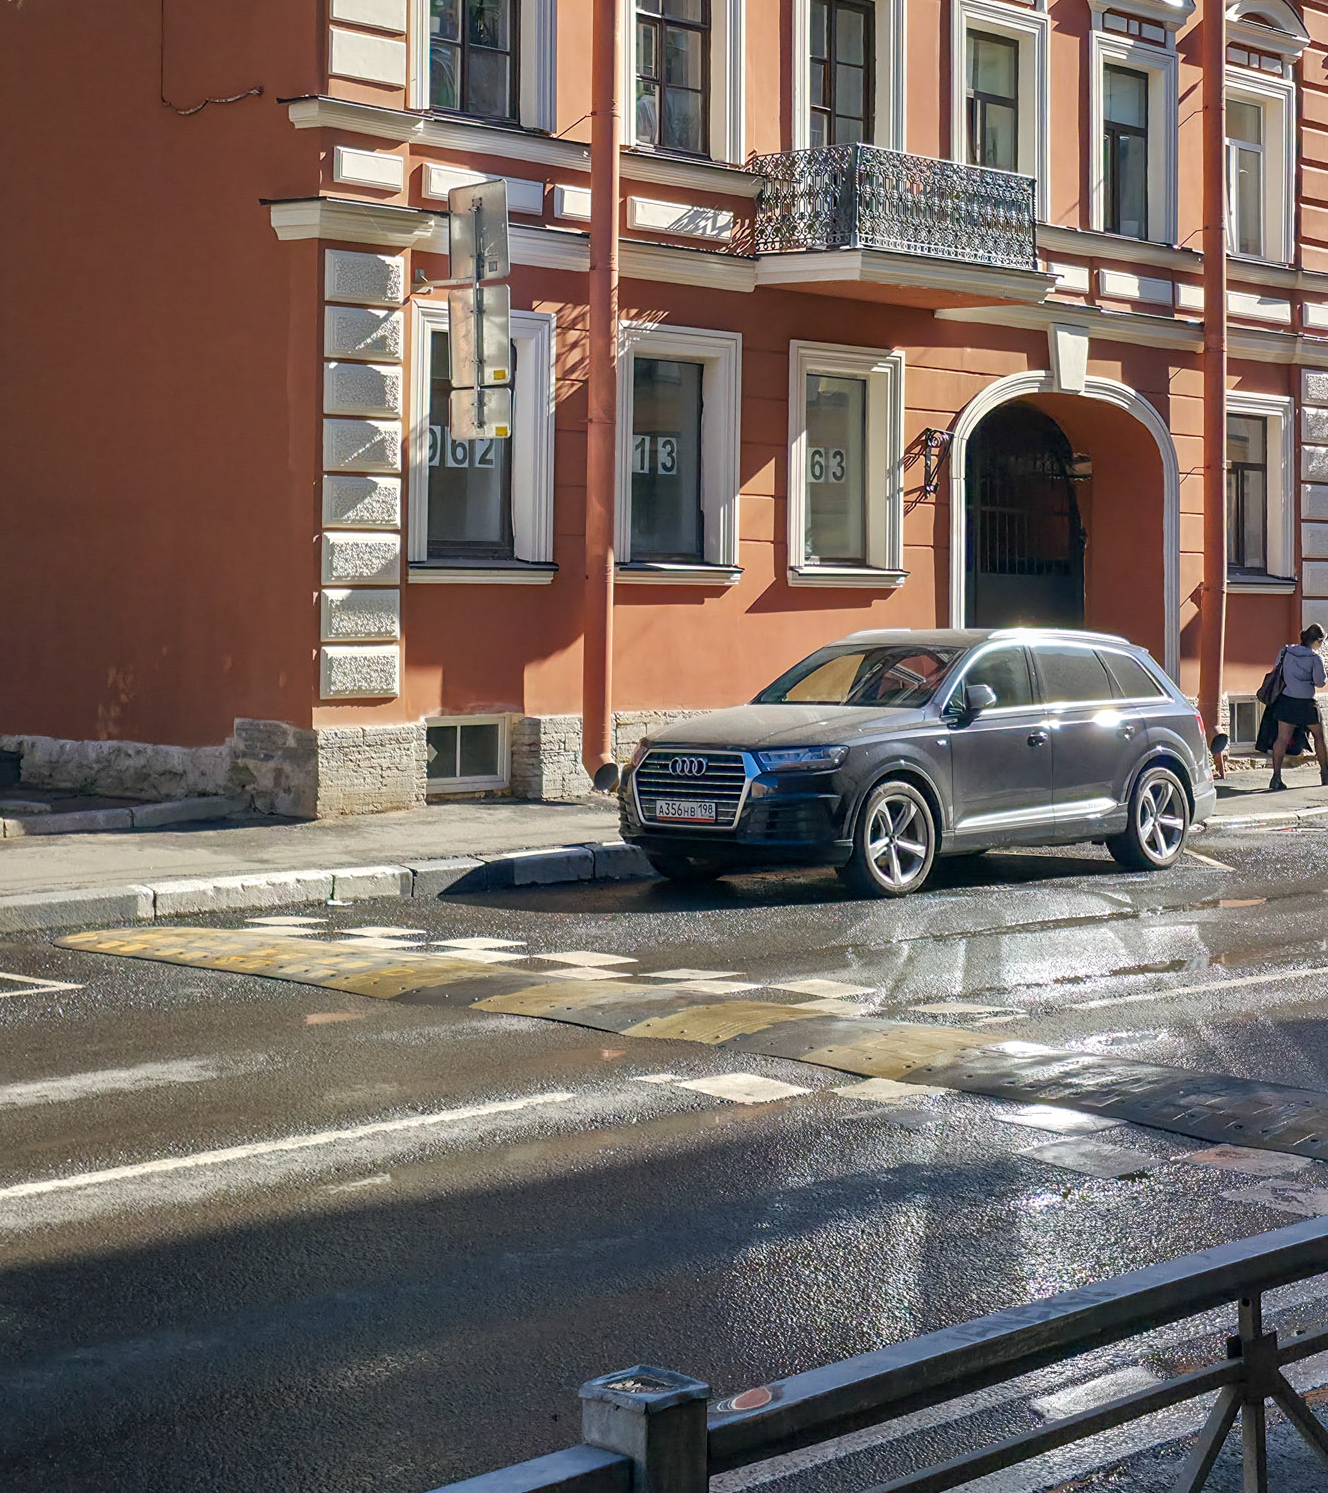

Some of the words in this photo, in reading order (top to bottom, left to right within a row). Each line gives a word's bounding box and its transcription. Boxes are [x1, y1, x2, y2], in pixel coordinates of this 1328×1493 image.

[635, 437, 675, 472] 13
[811, 449, 845, 481] 63
[659, 802, 695, 817] А356НВ
